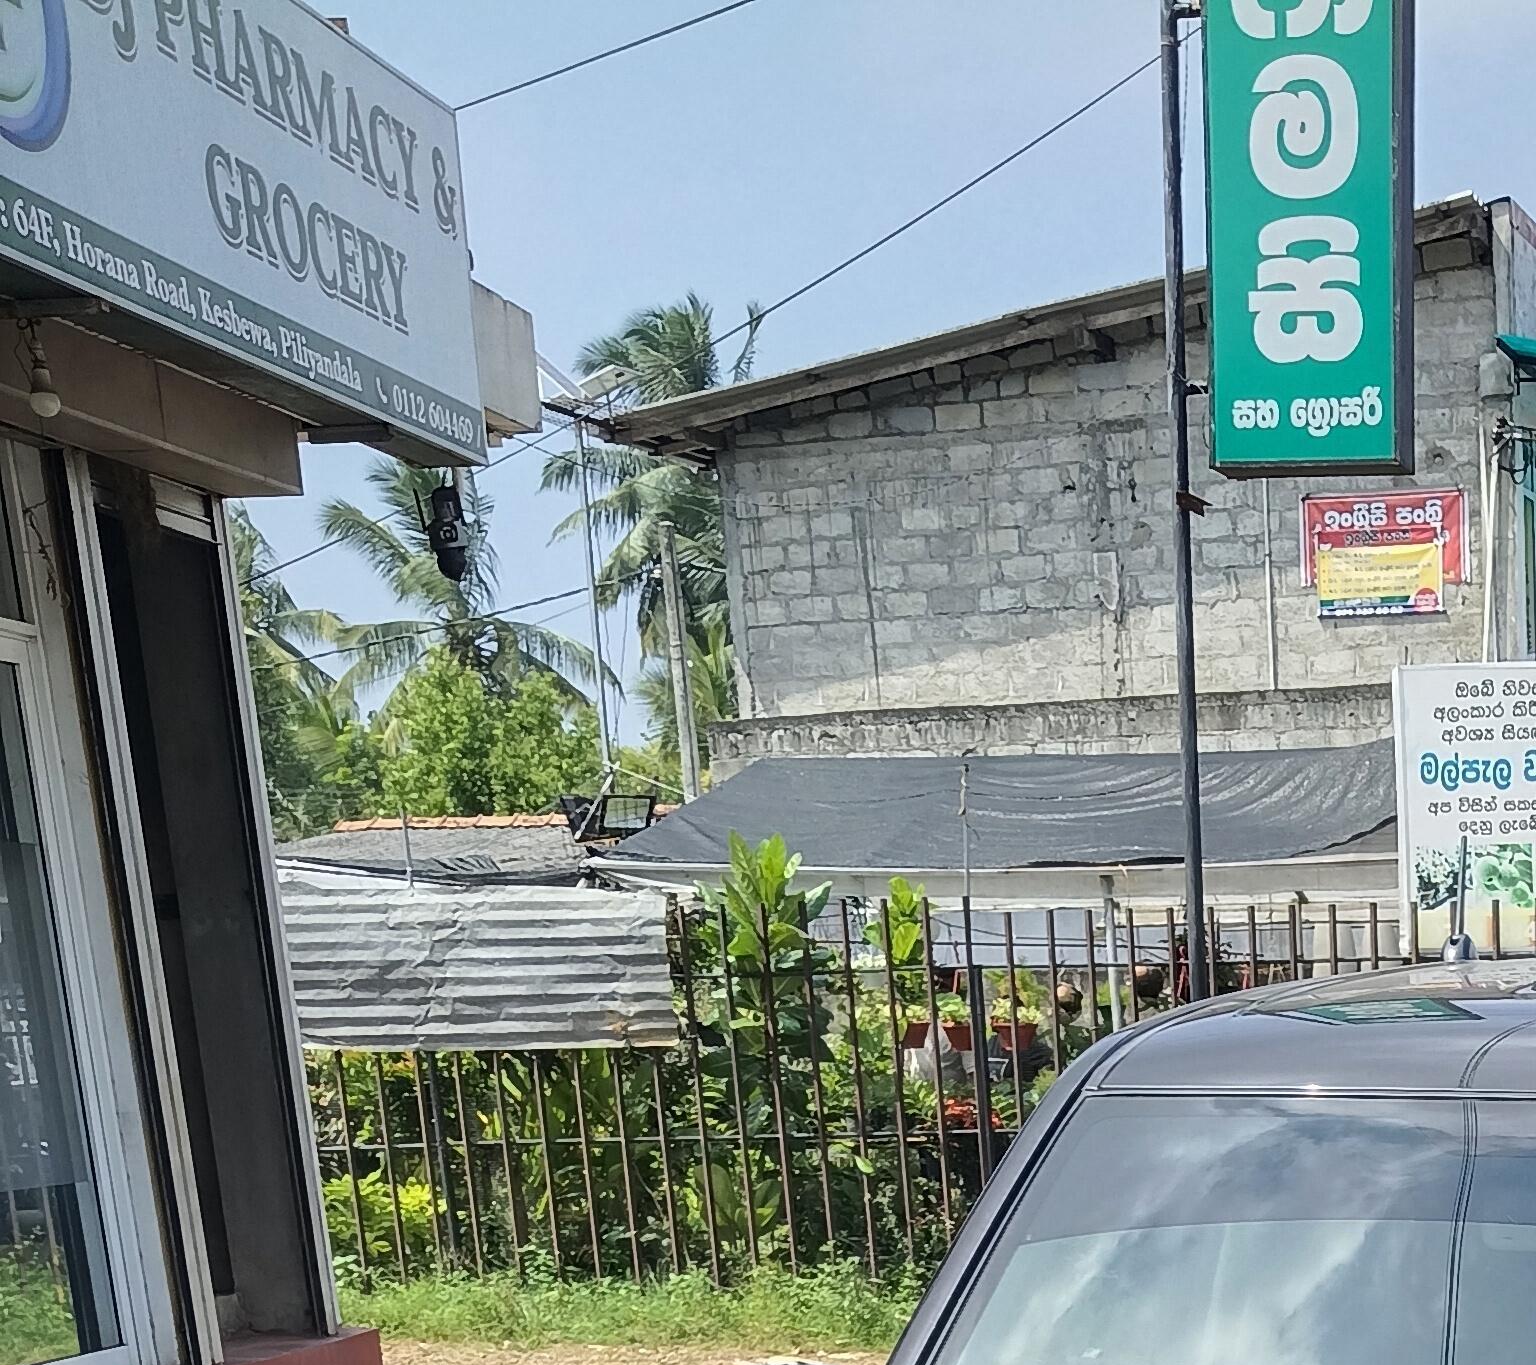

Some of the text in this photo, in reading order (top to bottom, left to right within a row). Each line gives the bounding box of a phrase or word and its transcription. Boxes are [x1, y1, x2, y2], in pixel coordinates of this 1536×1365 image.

[155, 0, 420, 213] PHARMACY
[431, 146, 458, 240] &
[205, 143, 410, 336] GROCERY
[62, 220, 141, 290] Horana
[141, 259, 197, 321] Road,
[197, 286, 278, 358] Kesbewa,
[278, 325, 363, 393] Piliyandala
[392, 384, 427, 425] 0112
[1232, 399, 1280, 429] සහ
[1455, 679, 1495, 698] ඔබේ
[1433, 701, 1505, 723] අලංකාර
[1441, 725, 1495, 745] අවශ්‍ය
[1420, 752, 1512, 791] මල්පැල
[1428, 801, 1452, 816] අප
